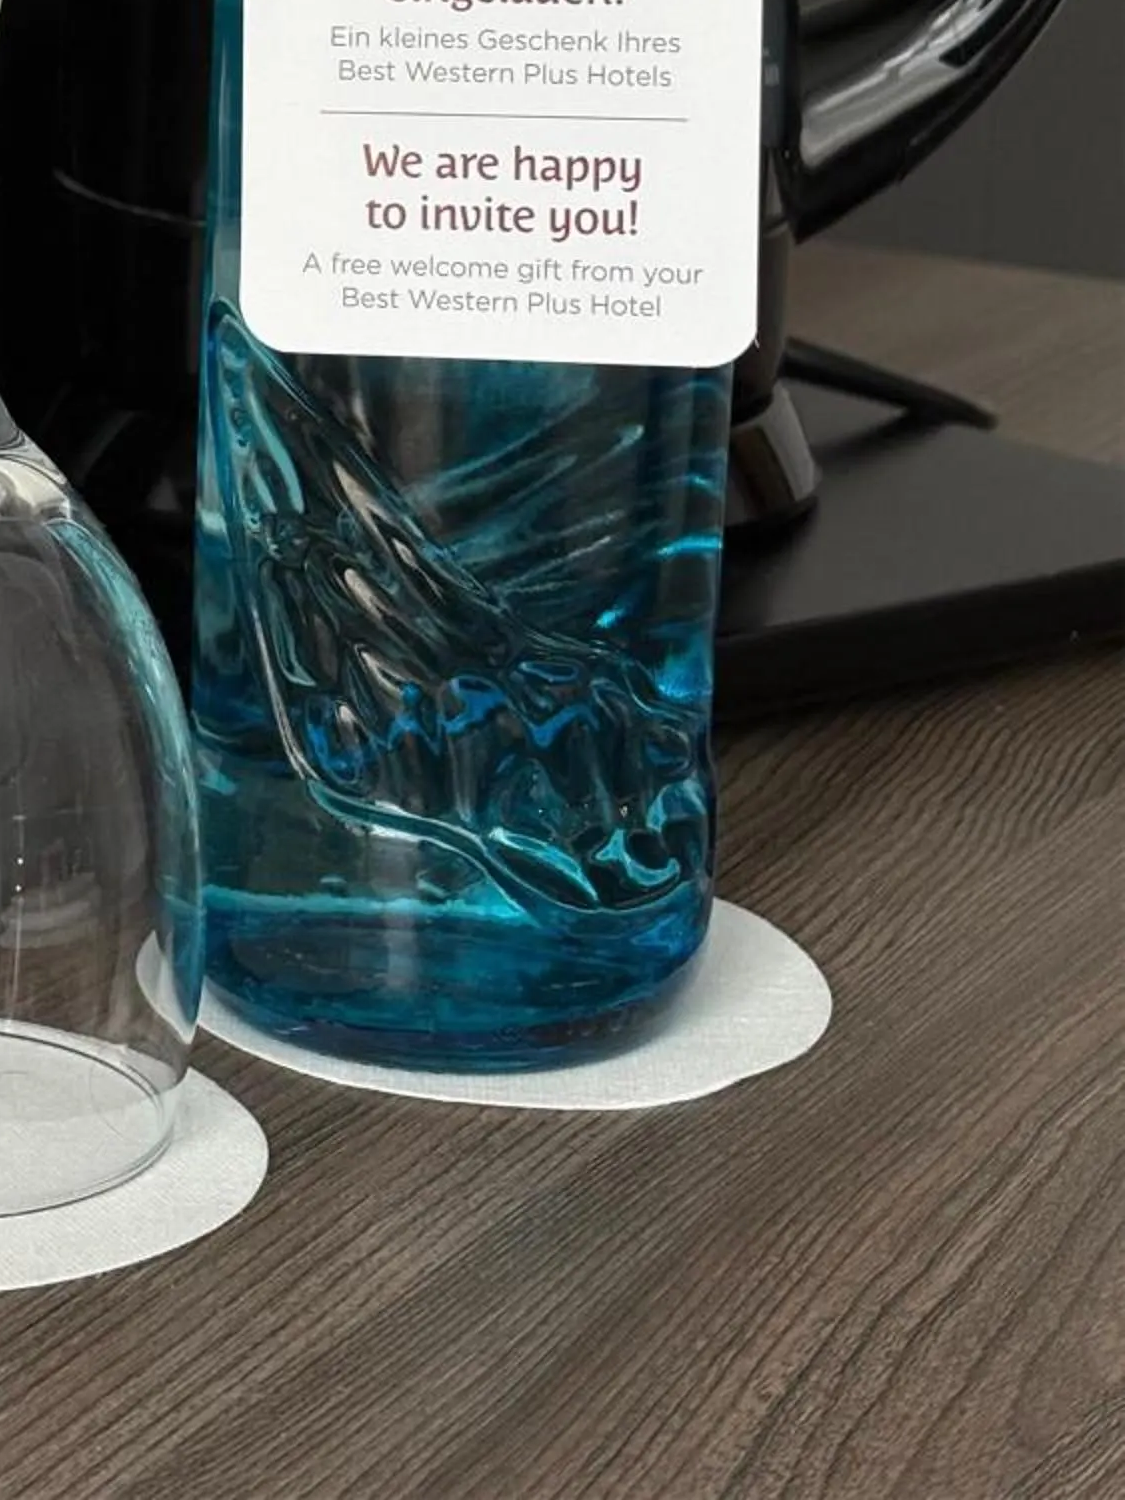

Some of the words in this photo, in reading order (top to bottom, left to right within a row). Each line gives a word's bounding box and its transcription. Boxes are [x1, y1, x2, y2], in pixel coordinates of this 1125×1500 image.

[330, 26, 370, 48] Ein
[379, 26, 469, 49] kleines
[477, 29, 608, 52] Geschenk
[618, 31, 682, 54] Ihres
[338, 60, 396, 82] Best
[405, 62, 515, 84] Western
[524, 64, 578, 85] Plus
[587, 65, 672, 88] Hotels
[363, 144, 423, 179] We
[435, 153, 499, 181] are
[514, 145, 642, 192] happy
[365, 200, 407, 231] to
[421, 195, 535, 234] invite
[549, 200, 639, 243] you!
[302, 252, 322, 274] A
[331, 252, 382, 276] free
[390, 255, 509, 279] welcome
[518, 259, 563, 284] gift
[571, 260, 634, 283] from
[642, 267, 704, 288] your
[342, 287, 399, 309] Best
[408, 289, 518, 313] Western
[527, 293, 581, 316] Plus
[590, 294, 661, 317] Hotel
